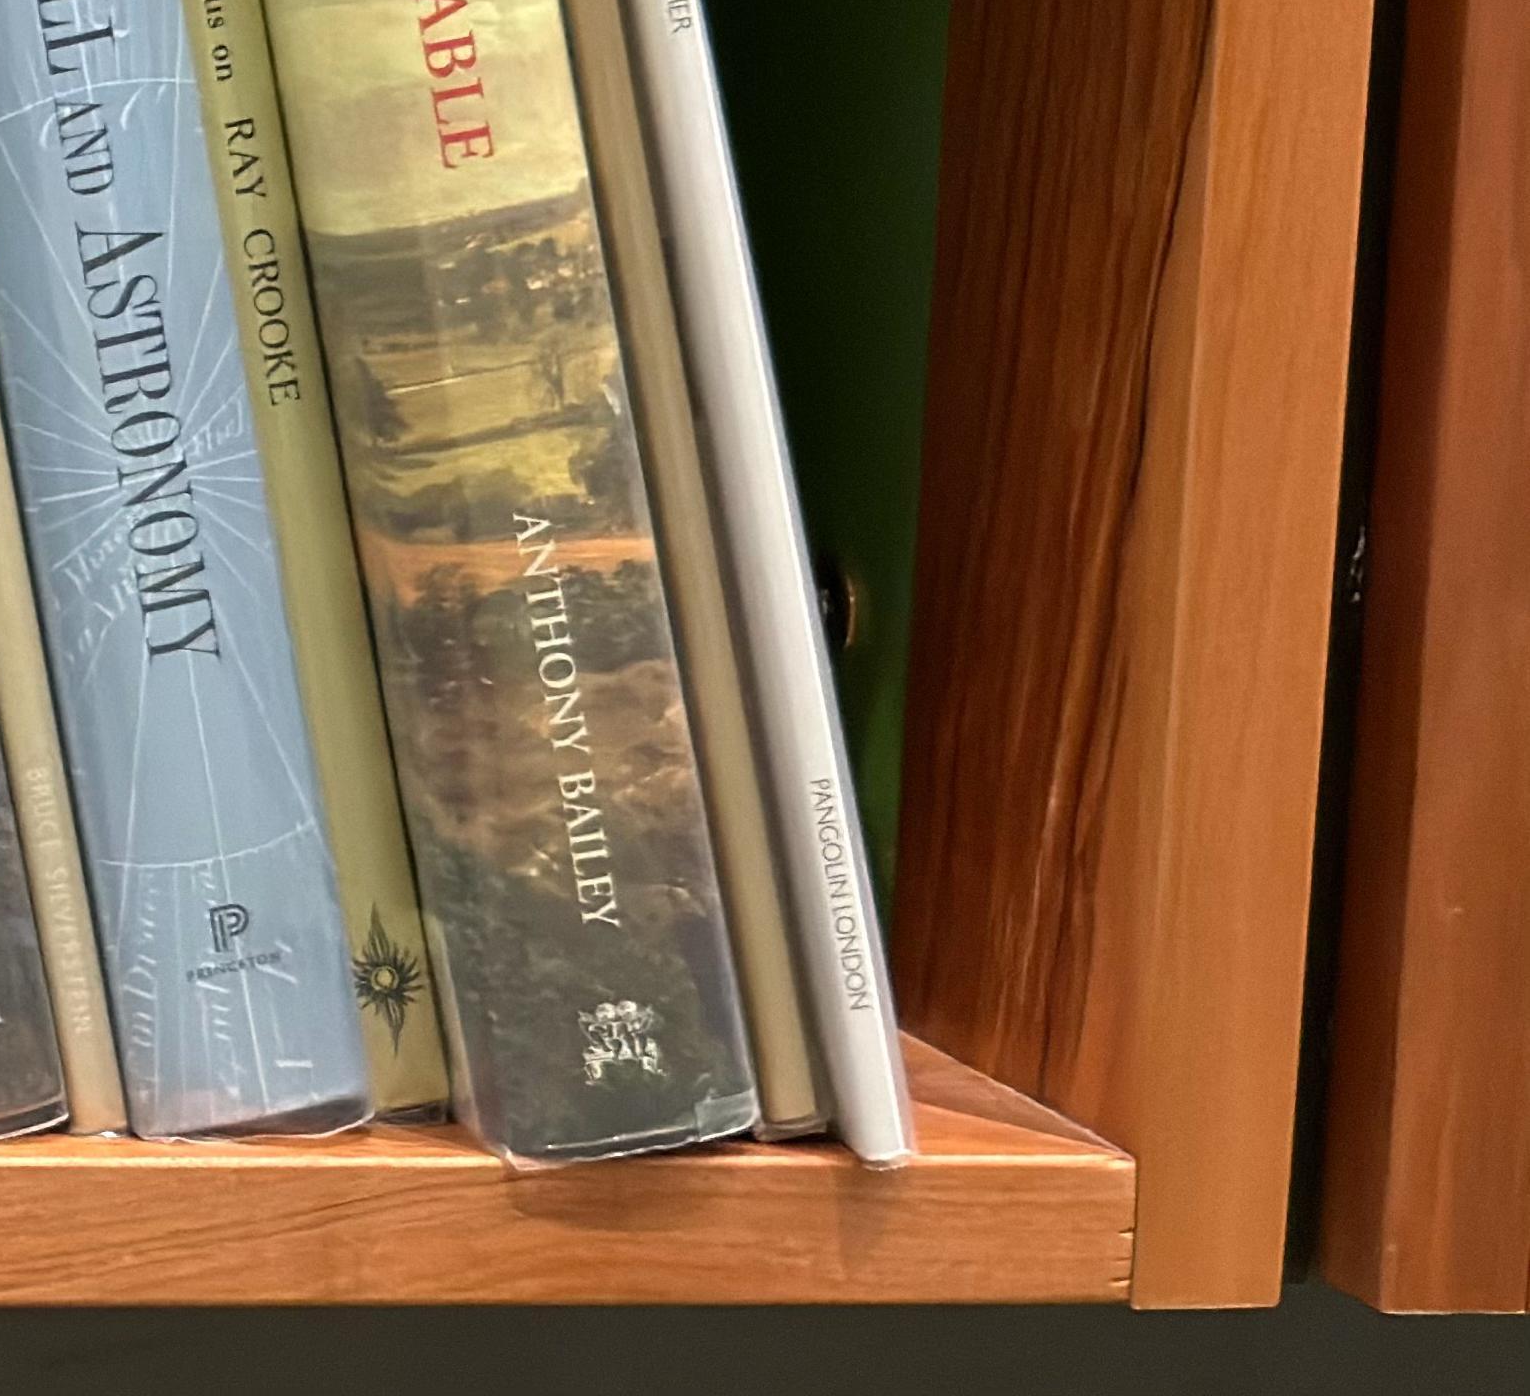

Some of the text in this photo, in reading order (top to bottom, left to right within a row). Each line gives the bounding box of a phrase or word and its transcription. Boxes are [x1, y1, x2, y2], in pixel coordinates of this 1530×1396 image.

[55, 101, 115, 196] AND
[211, 43, 234, 83] on
[224, 116, 268, 201] RAY
[242, 227, 301, 407] CROOKE
[75, 221, 221, 663] ASTRONOMY
[512, 510, 591, 757] ANTHONY
[557, 768, 621, 930] BAILEY
[809, 777, 874, 1013] PANGOLIN LONDON
